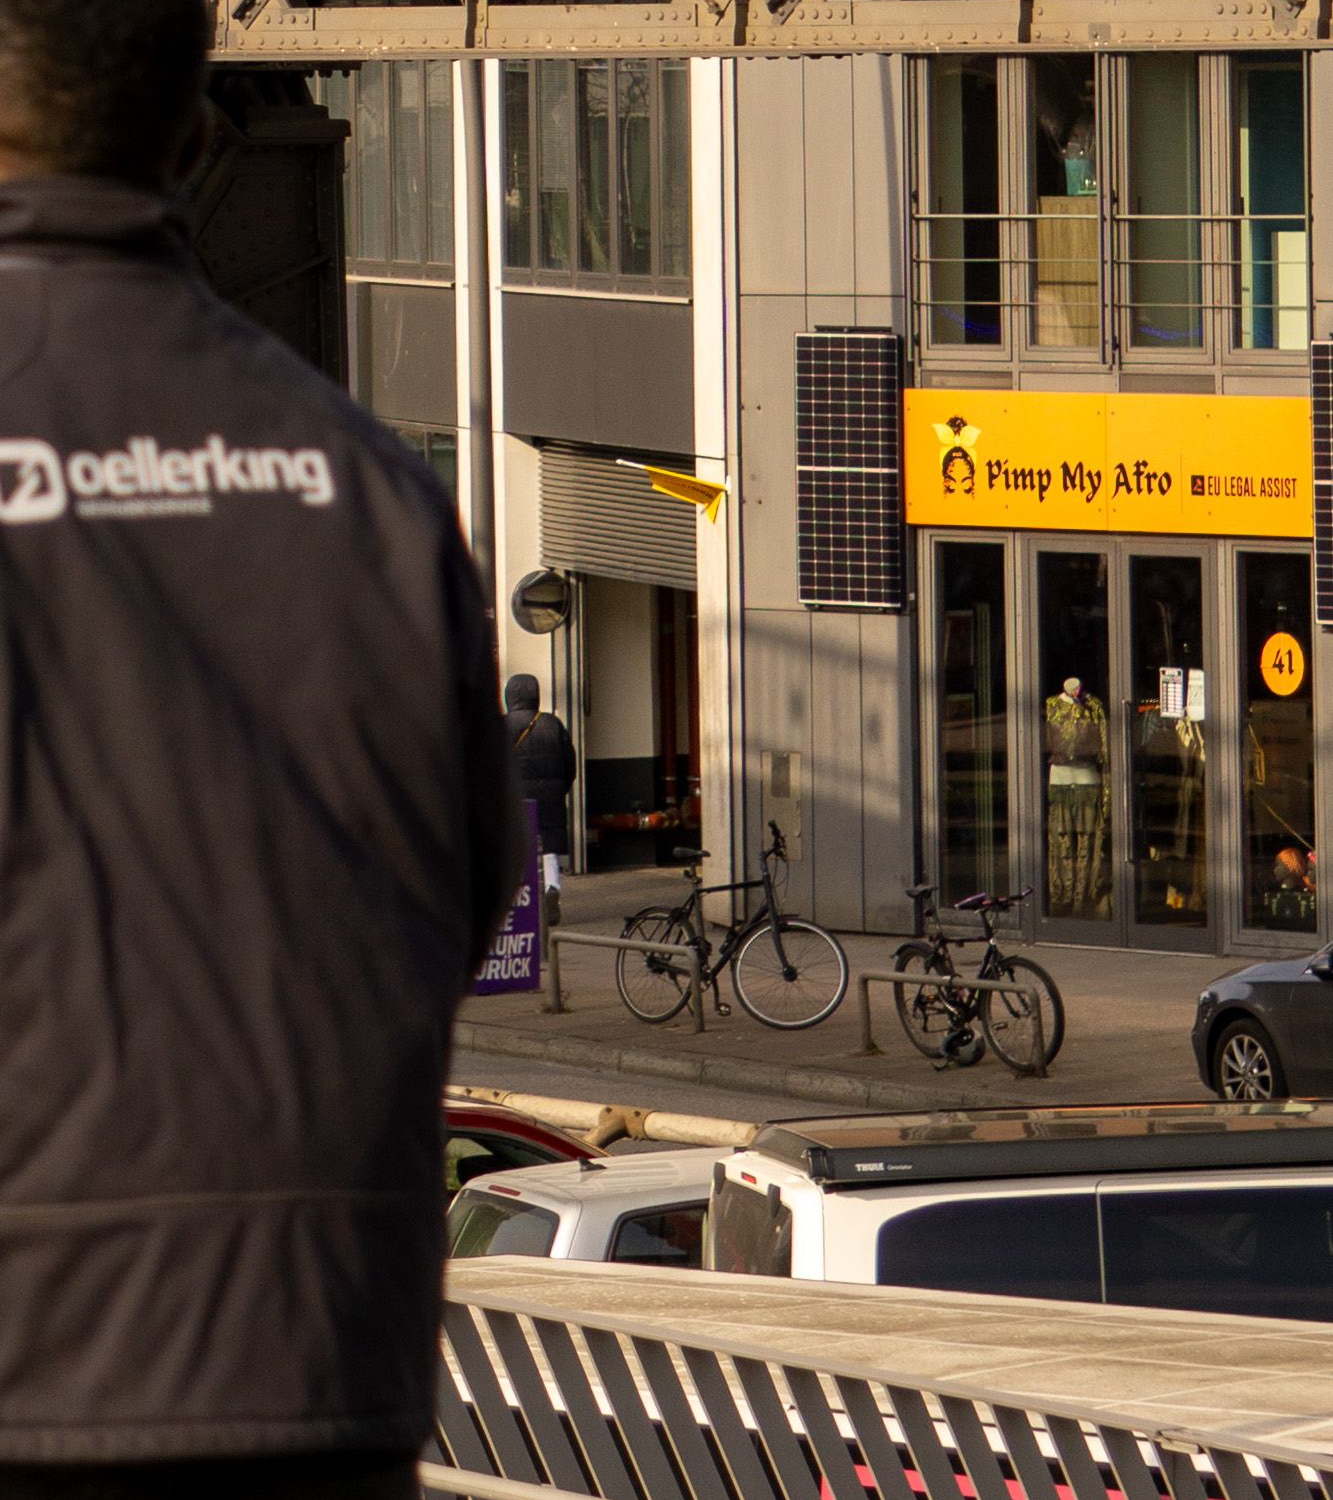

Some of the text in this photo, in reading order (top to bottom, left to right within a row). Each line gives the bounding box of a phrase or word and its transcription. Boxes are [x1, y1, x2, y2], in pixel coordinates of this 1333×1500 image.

[986, 458, 1172, 503] Pimp My Afro
[1208, 476, 1297, 499] EU LEGAL ASSIST
[1272, 648, 1295, 675] 41
[493, 932, 535, 957] UNFT
[854, 1162, 885, 1172] THULE
